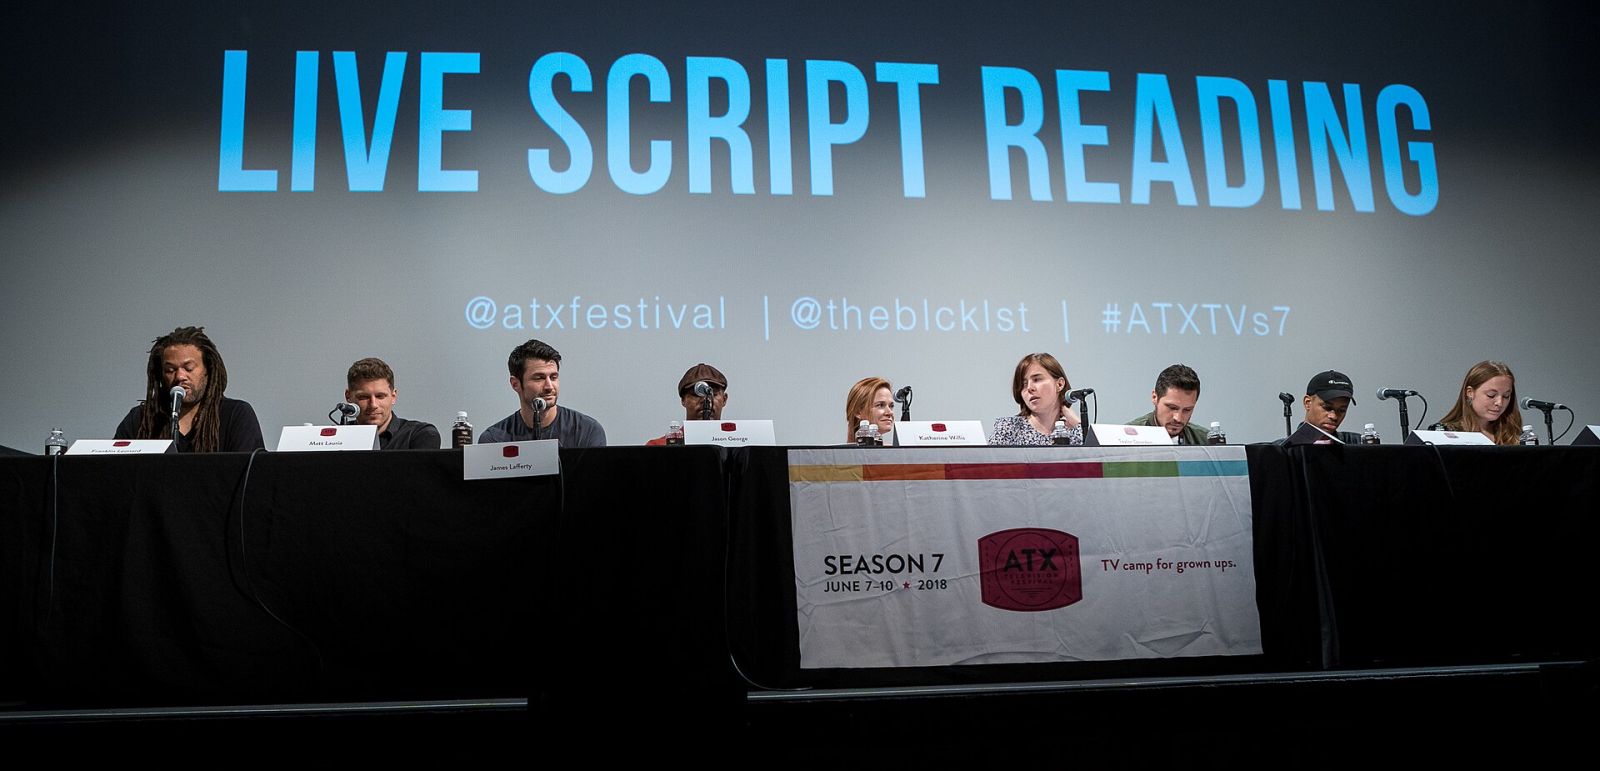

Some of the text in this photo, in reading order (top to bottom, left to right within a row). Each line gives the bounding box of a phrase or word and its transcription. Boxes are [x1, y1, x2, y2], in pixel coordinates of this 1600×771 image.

[218, 50, 1440, 216] LIVE SCRIPT READING
[465, 295, 726, 330] @atxfestival
[791, 297, 1030, 333] @theblcklst
[1101, 302, 1291, 336] #ATXTVs7
[824, 553, 945, 575] SEASON 7
[1003, 547, 1059, 573] ATX
[1101, 558, 1237, 575] TV camp for grown ups.
[824, 580, 861, 592] JUNE
[918, 579, 948, 591] 2018
